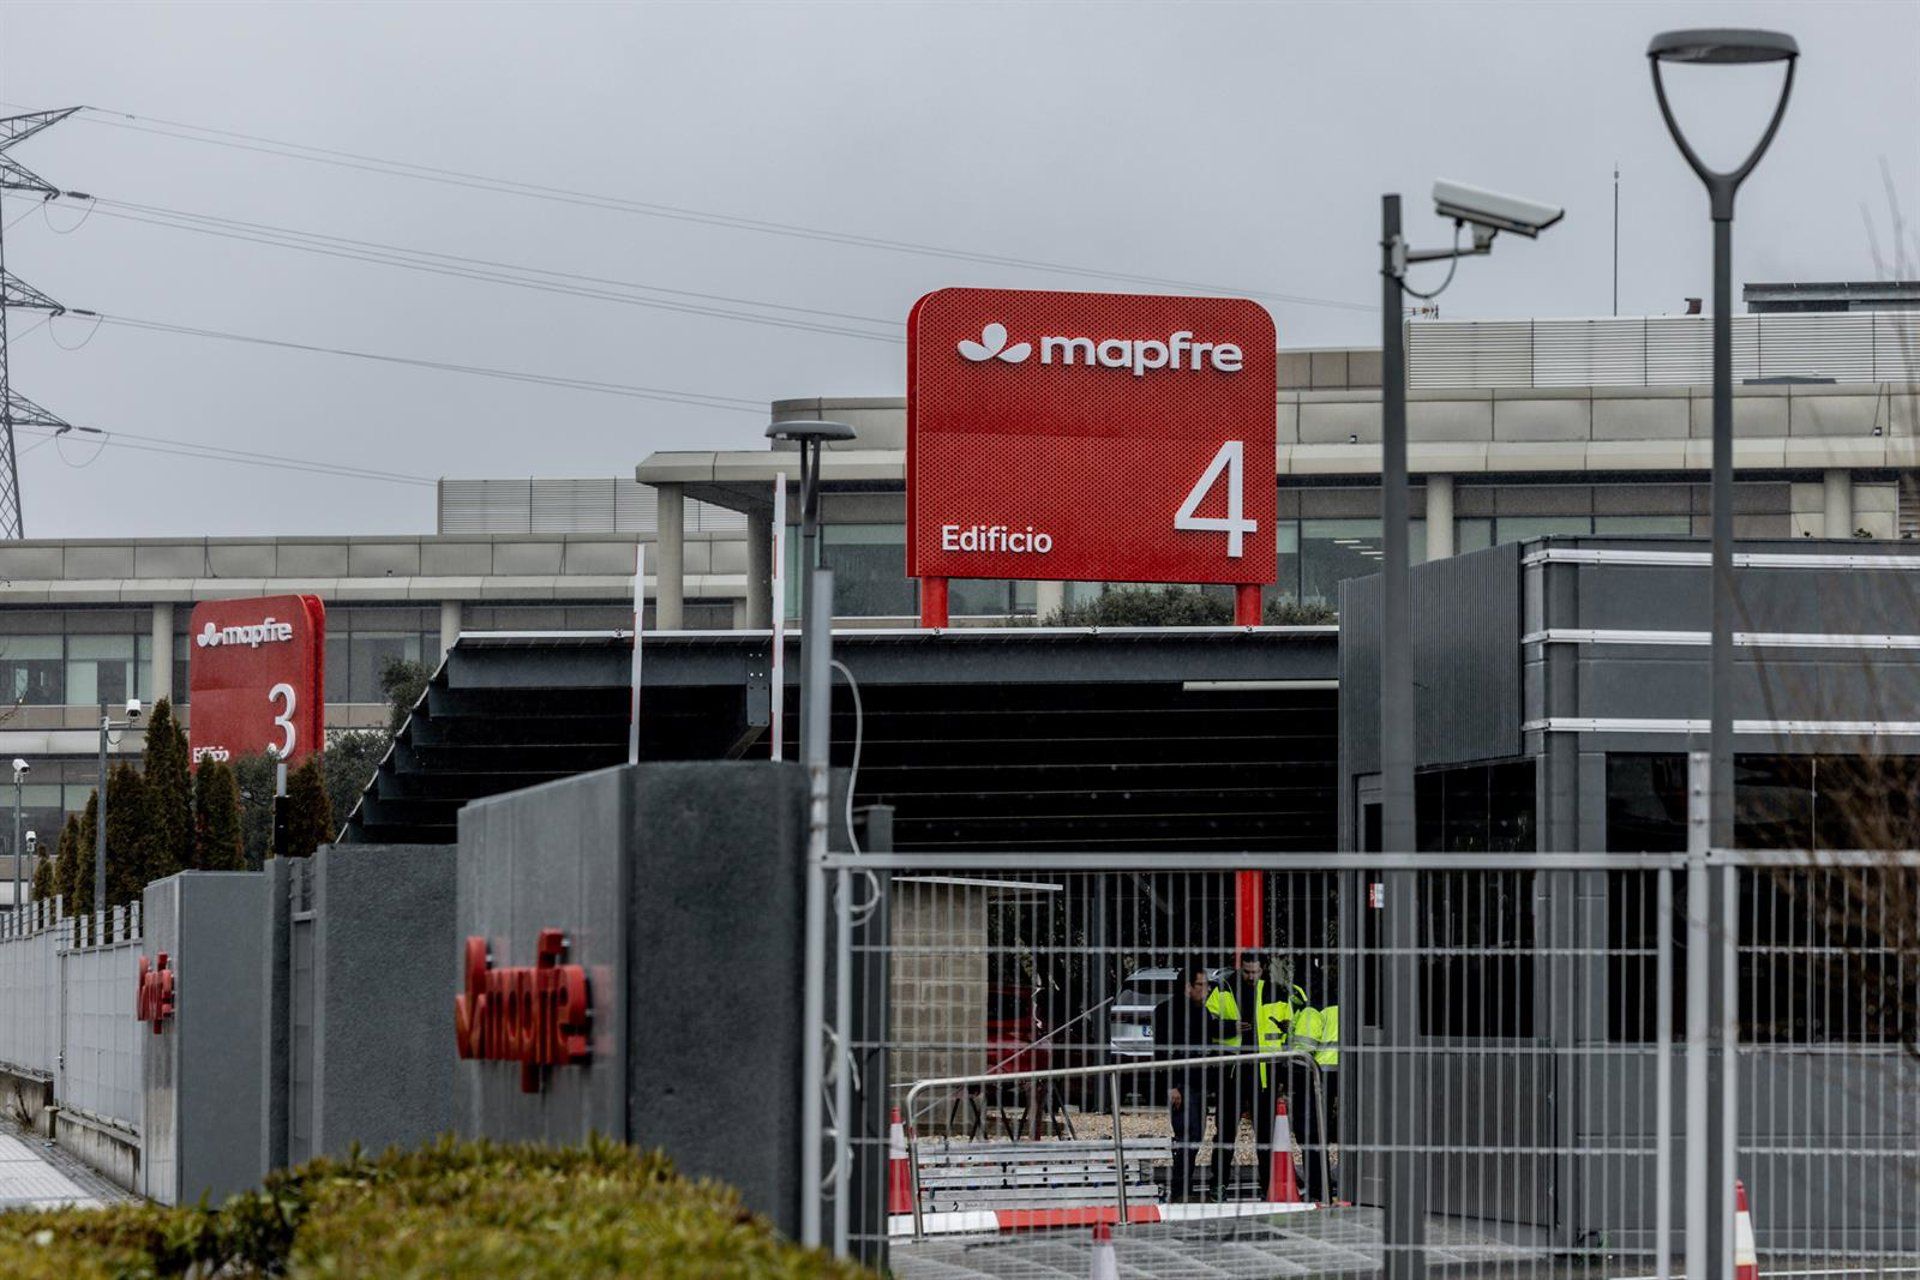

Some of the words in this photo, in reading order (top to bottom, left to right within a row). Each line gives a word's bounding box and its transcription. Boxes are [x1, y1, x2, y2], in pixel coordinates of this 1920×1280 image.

[1040, 331, 1243, 377] mapfre
[941, 524, 1053, 554] Edificio
[1174, 440, 1258, 558] 4
[222, 617, 292, 648] mapfre
[267, 683, 296, 760] 3
